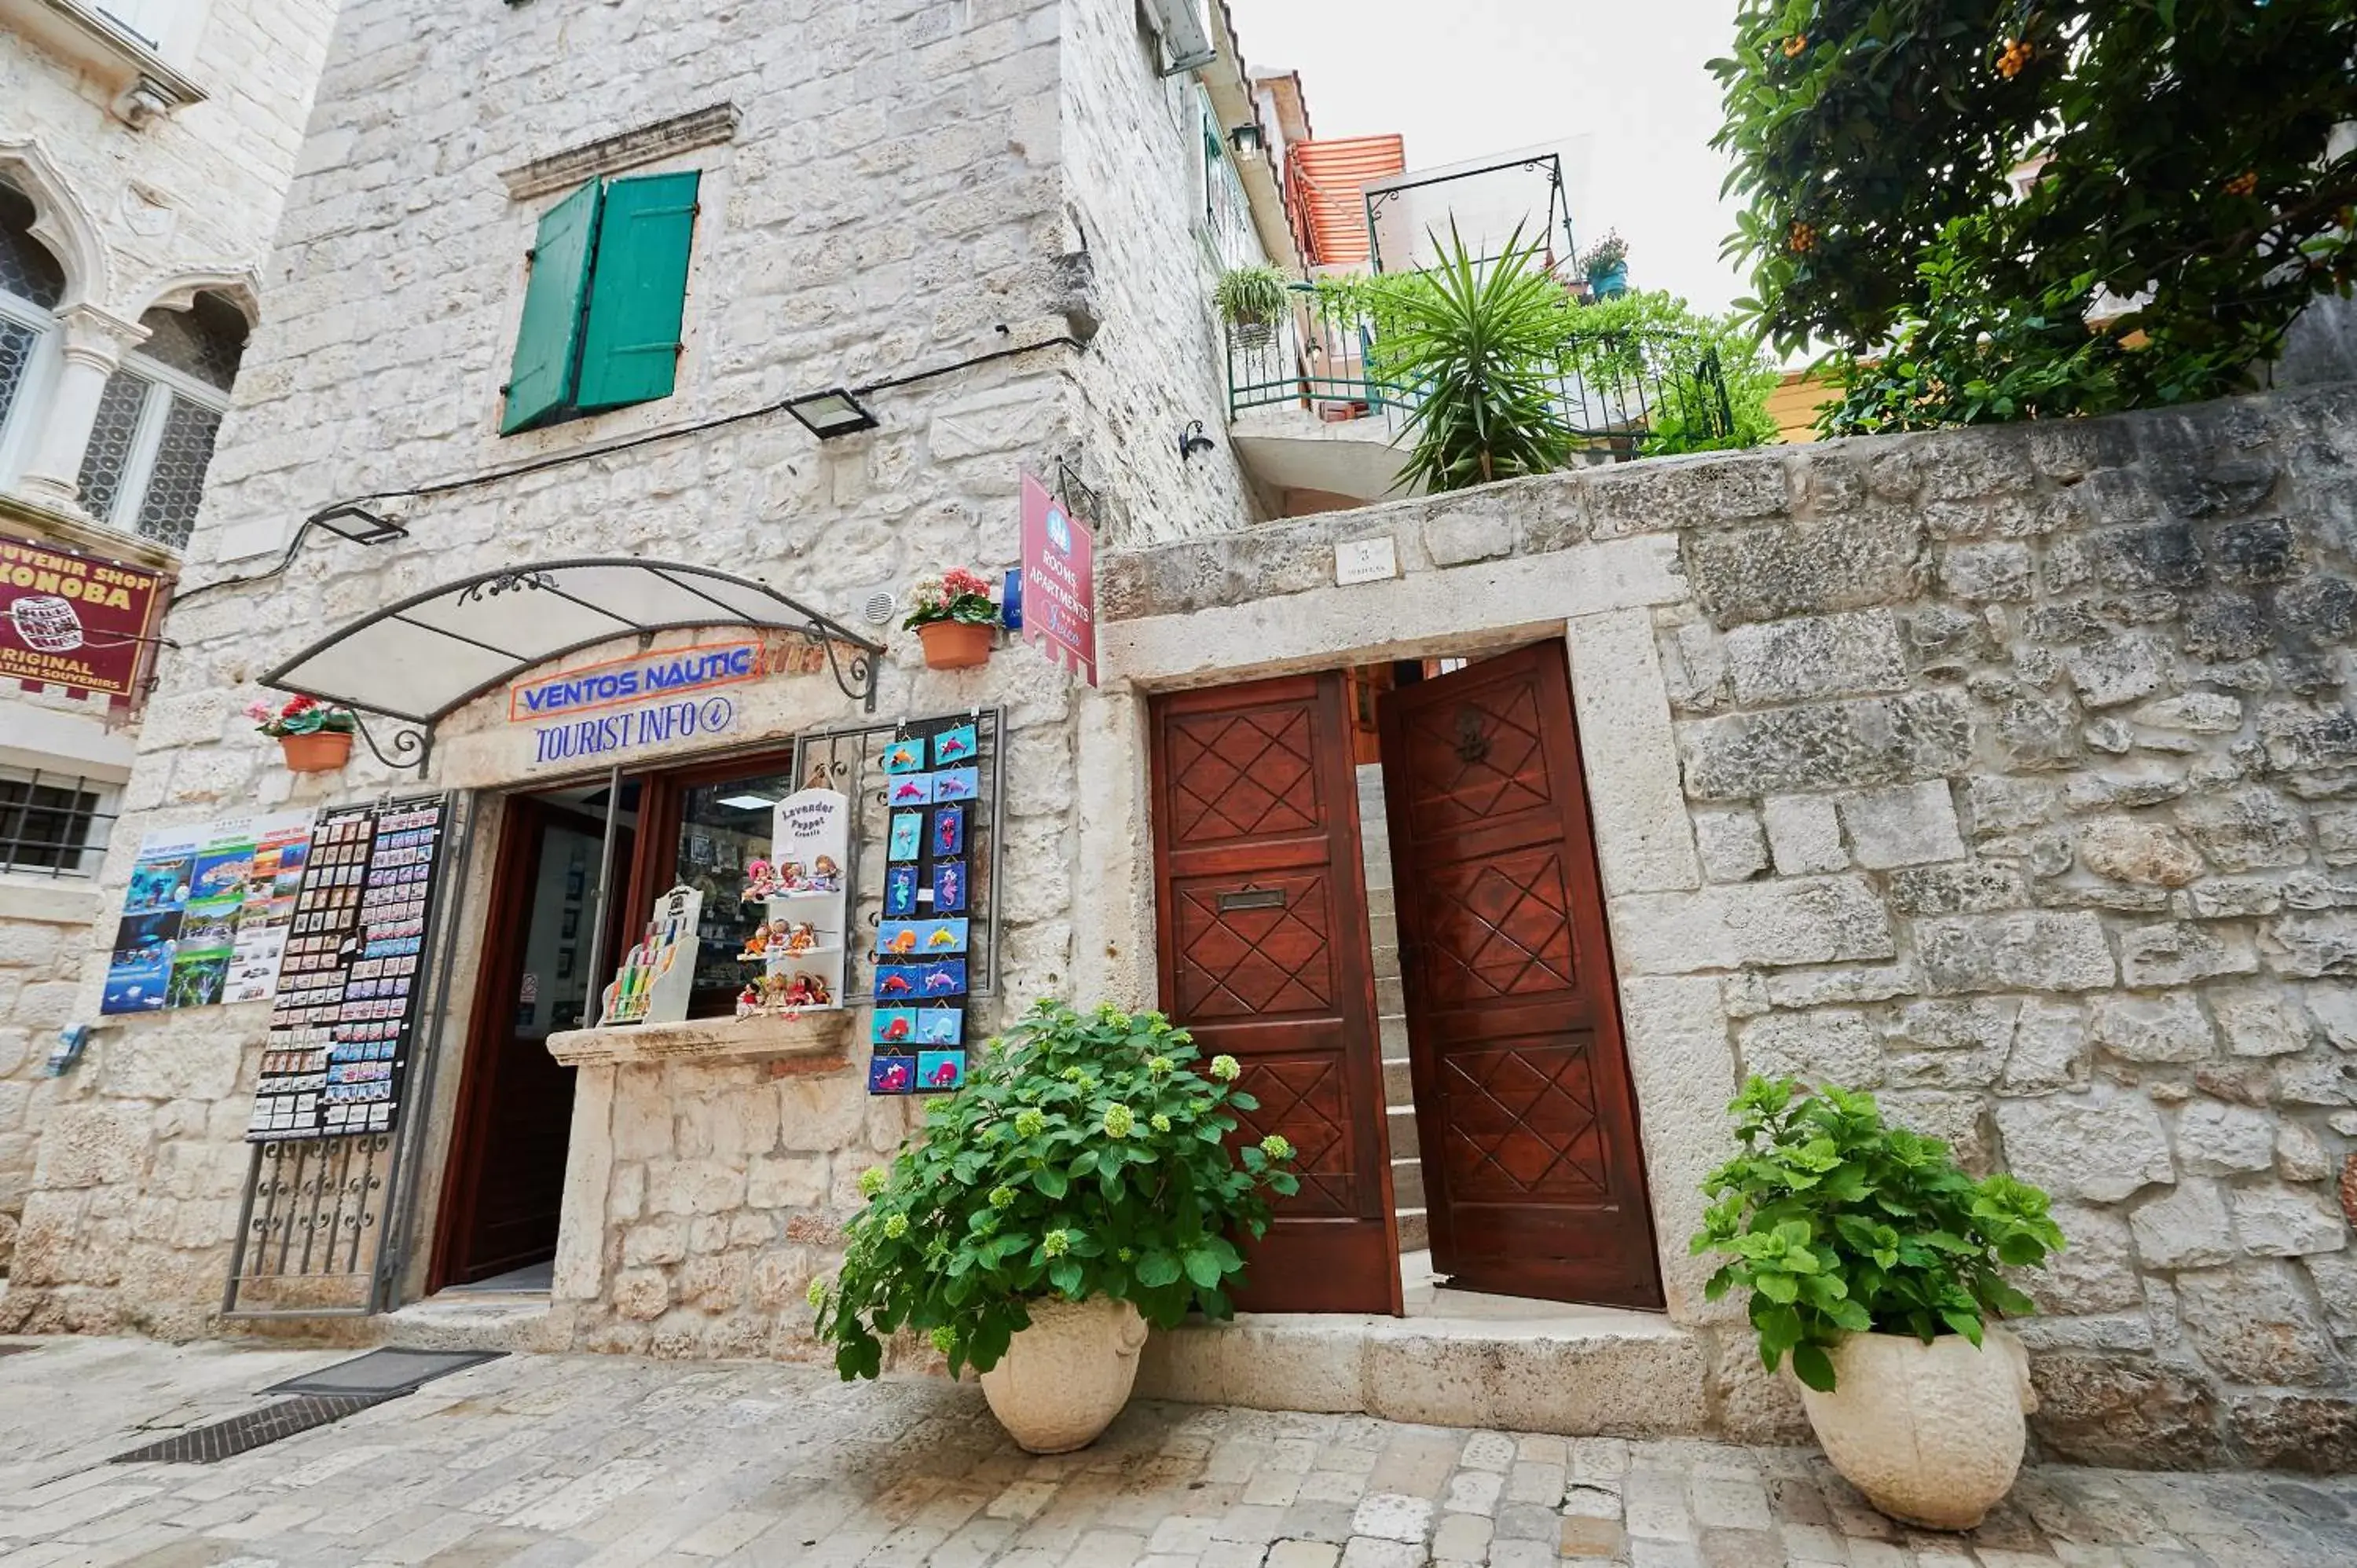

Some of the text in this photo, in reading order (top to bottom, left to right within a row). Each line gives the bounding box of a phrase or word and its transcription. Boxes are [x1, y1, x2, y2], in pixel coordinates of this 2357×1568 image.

[0, 544, 152, 590] UVENIR SHOP
[0, 562, 130, 610] KONOBA
[1043, 549, 1077, 586] ROOMS
[1030, 566, 1090, 622] APARTMENTS
[0, 647, 93, 675] RIGINAL
[41, 669, 120, 689] SOUVENIRS
[525, 647, 750, 711] VENTOS NAUTIC
[536, 713, 634, 762] TOURIST
[638, 702, 695, 744] INFO
[782, 801, 834, 820] Lavender
